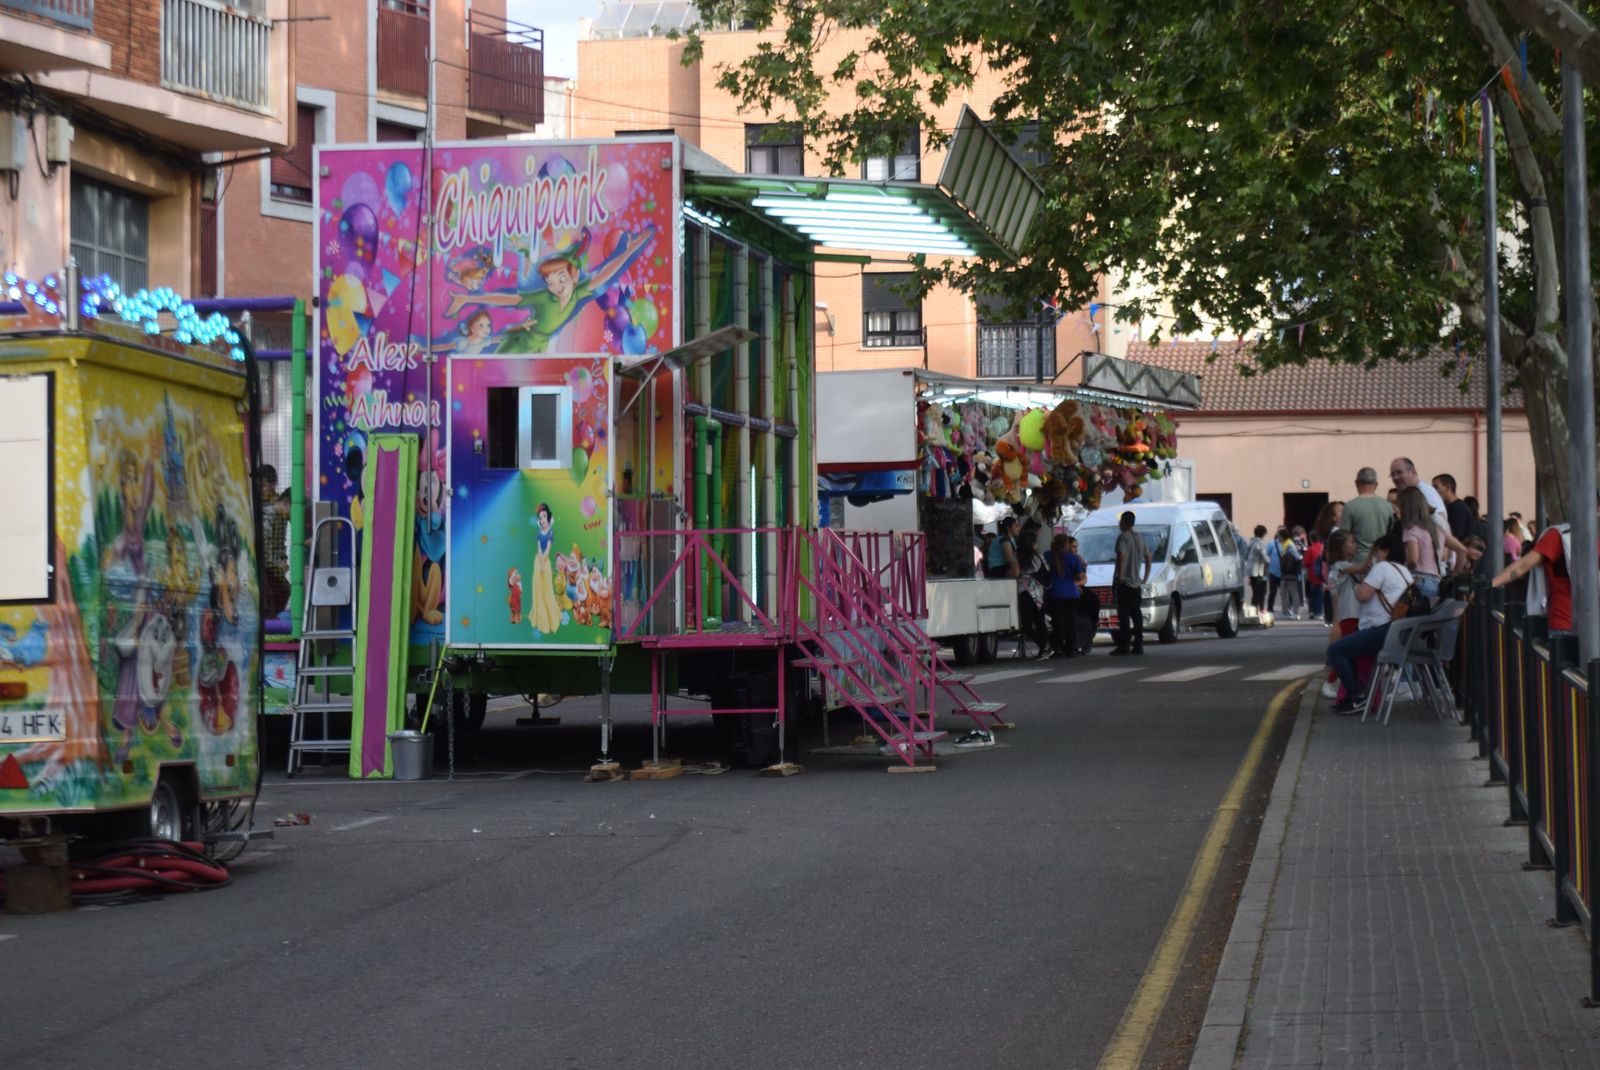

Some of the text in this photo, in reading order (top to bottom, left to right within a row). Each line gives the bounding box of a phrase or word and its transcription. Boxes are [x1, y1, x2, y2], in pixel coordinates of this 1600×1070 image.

[435, 145, 608, 268] Chiquipark
[348, 332, 418, 371] Alex
[22, 714, 61, 735] HFK
